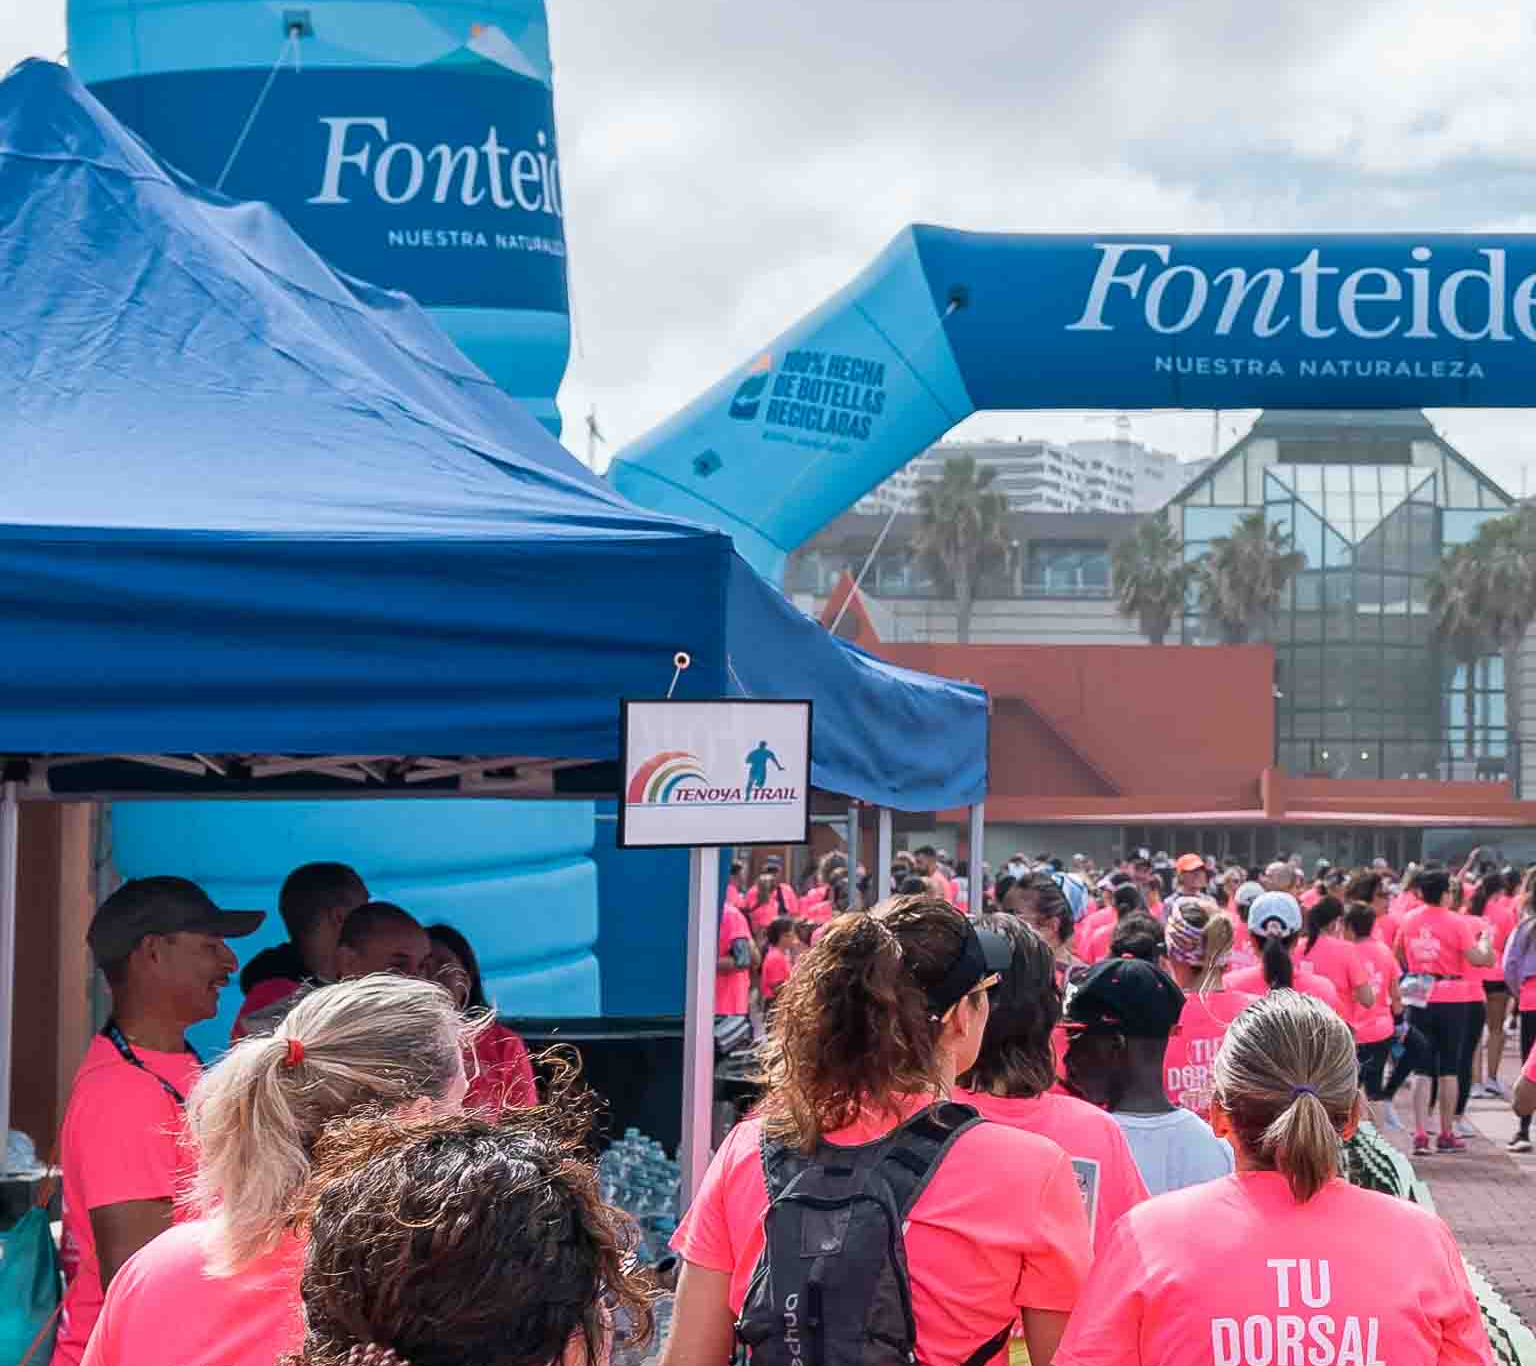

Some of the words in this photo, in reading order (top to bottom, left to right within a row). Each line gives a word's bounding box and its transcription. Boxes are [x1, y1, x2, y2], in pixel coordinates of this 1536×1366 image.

[388, 229, 489, 248] NUESTRA
[1154, 355, 1286, 377] NUESTRA
[1299, 359, 1486, 379] NATURALEZA
[676, 788, 741, 802] TENOYA
[752, 787, 799, 801] TRAIL
[1267, 1258, 1331, 1308] TU
